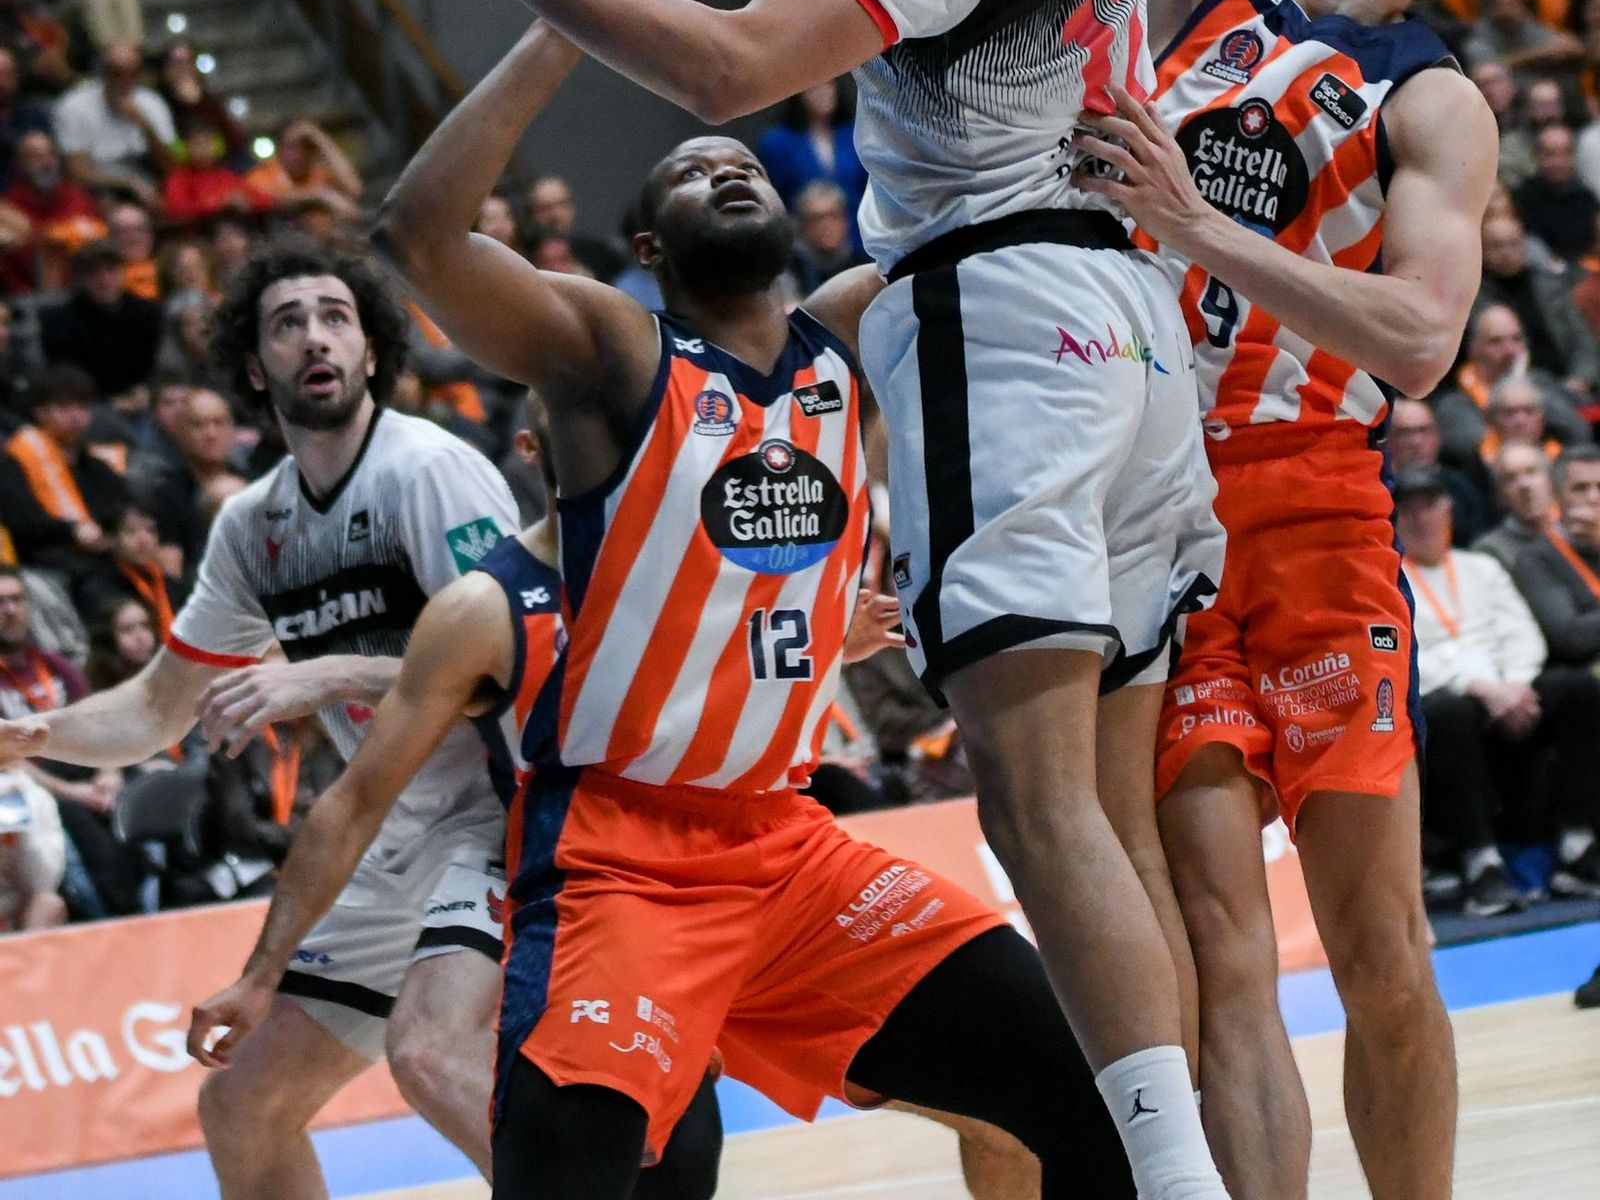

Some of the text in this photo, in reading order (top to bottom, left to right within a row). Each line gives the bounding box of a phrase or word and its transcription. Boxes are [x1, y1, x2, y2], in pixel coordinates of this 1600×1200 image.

[1314, 90, 1354, 126] endesa
[1193, 127, 1288, 189] Estrella
[1192, 162, 1279, 221] Galicia
[723, 475, 824, 509] Estrella
[729, 506, 820, 541] Galicia
[747, 607, 813, 681] 12
[1374, 636, 1395, 649] acb
[1260, 652, 1351, 695] A Coruña
[1295, 673, 1361, 704] PROVINCIA
[1198, 688, 1212, 699] DE
[1290, 687, 1359, 717] DESCUBRIR
